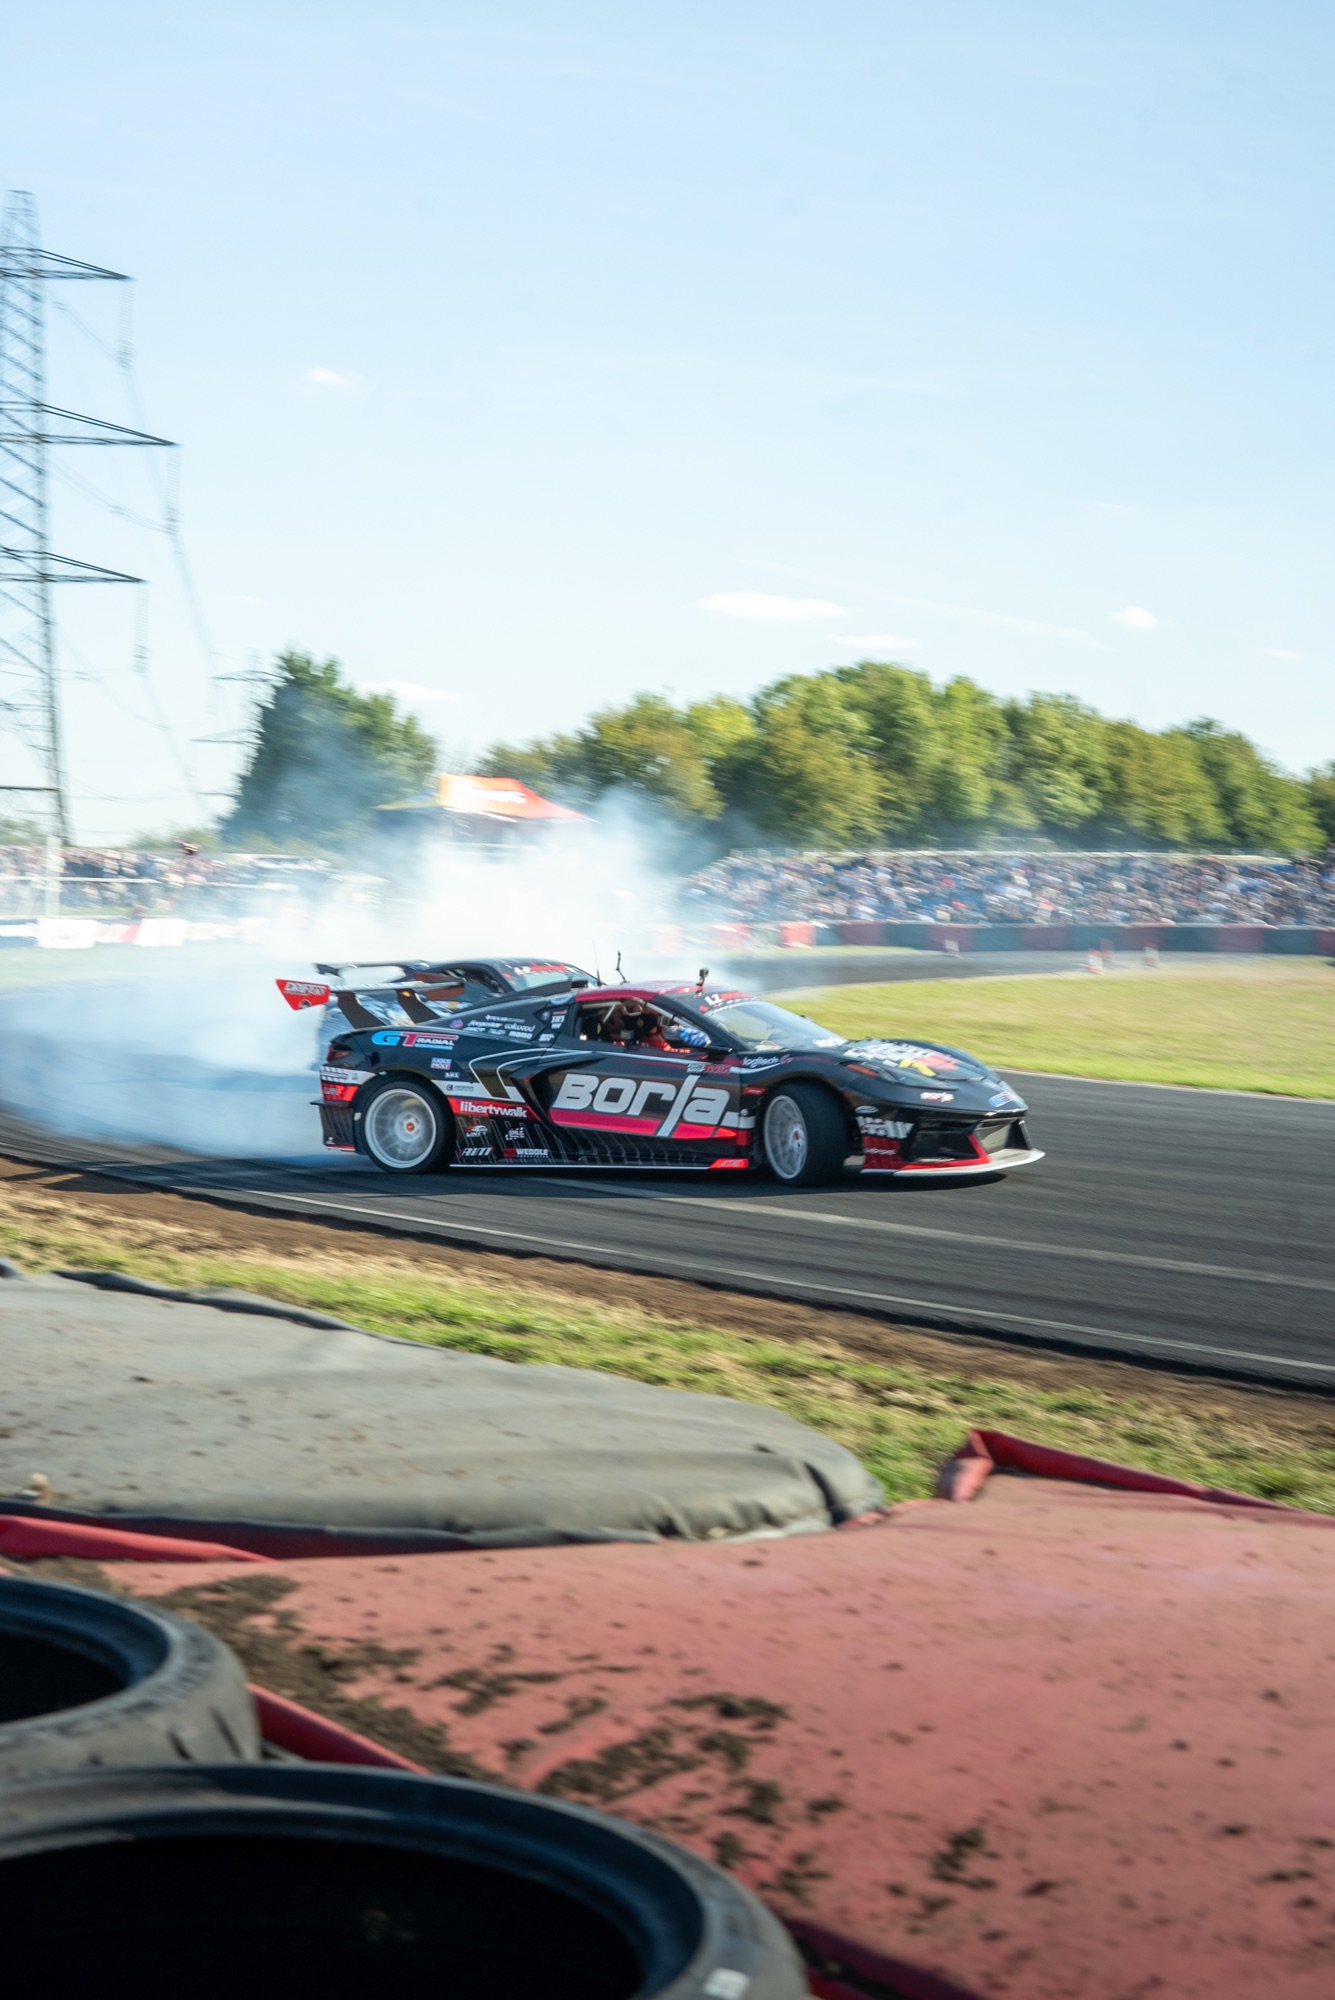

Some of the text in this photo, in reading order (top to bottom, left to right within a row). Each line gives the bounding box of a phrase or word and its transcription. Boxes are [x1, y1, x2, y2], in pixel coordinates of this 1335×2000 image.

[417, 1038, 455, 1047] RADIAL
[460, 1101, 527, 1118] libertywalk
[516, 1148, 549, 1156] WEDDLE
